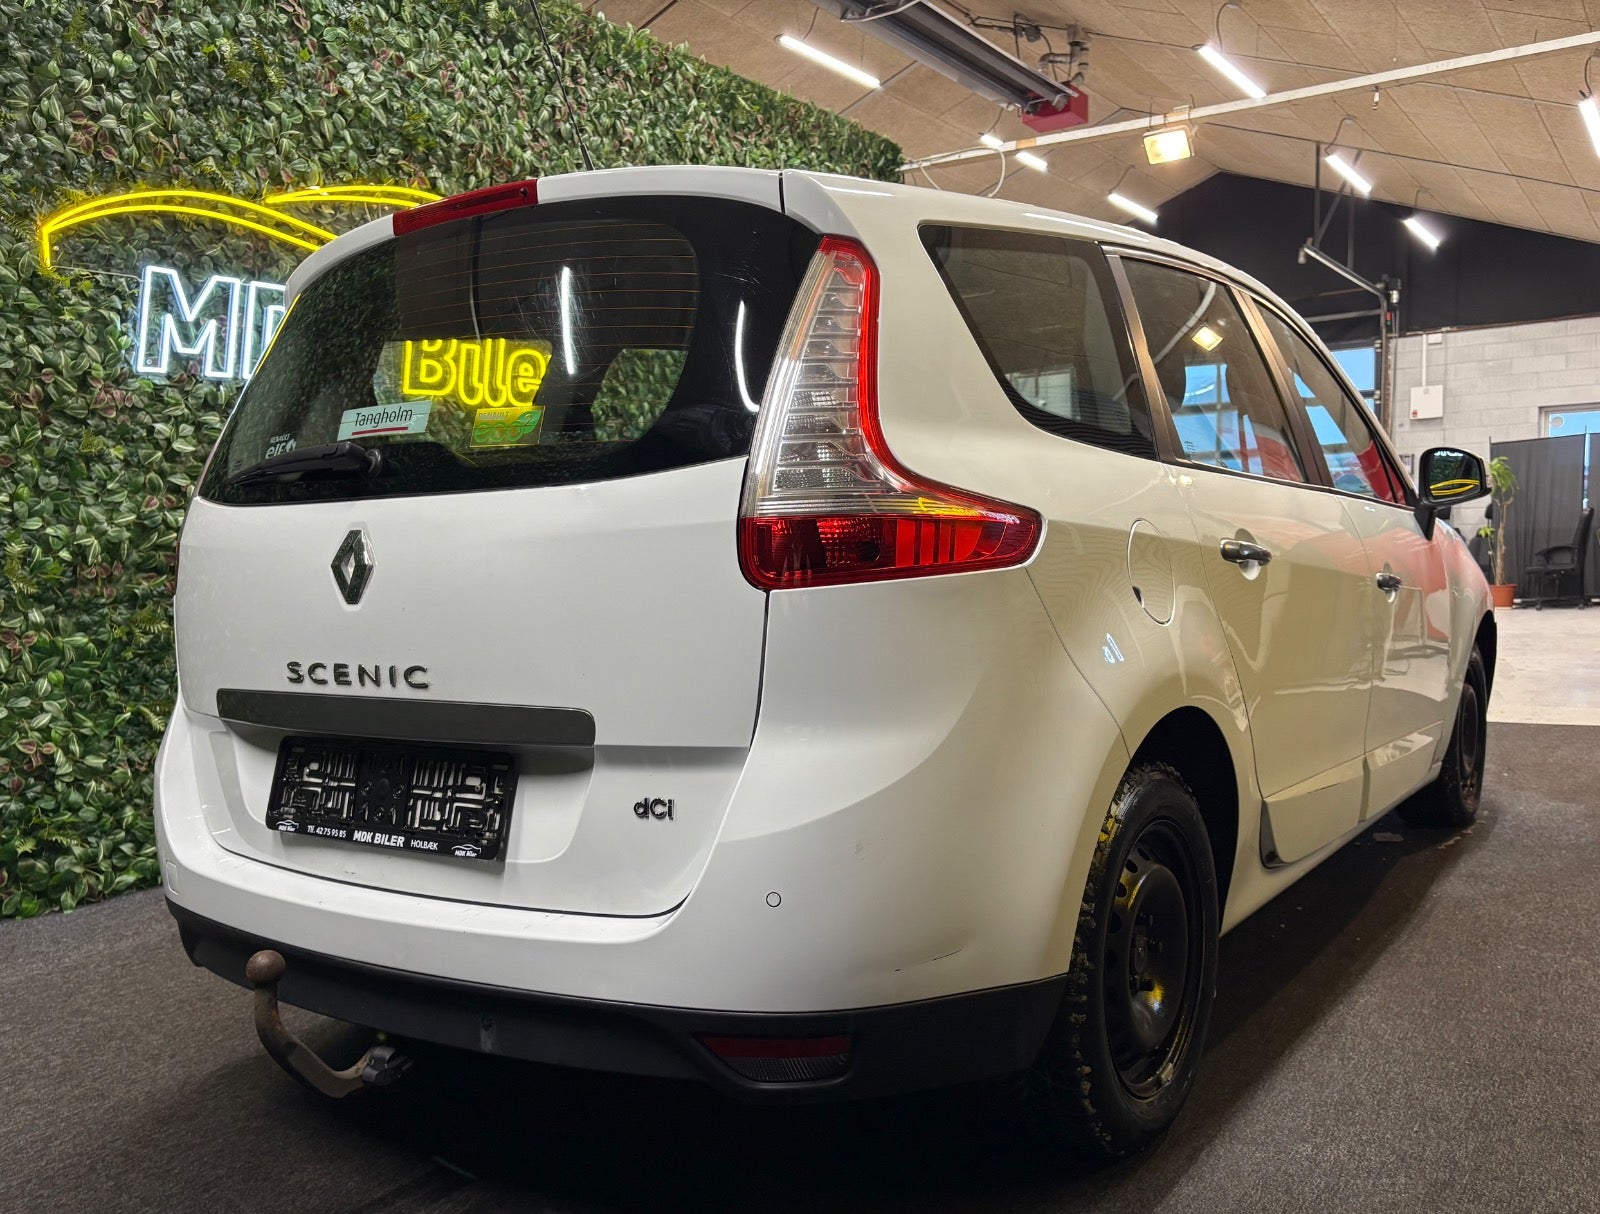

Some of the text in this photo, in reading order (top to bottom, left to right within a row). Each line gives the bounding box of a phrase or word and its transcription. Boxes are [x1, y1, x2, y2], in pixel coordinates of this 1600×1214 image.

[354, 406, 414, 428] Tangholm
[287, 661, 429, 689] SCENIC
[633, 797, 675, 821] dCi
[352, 830, 374, 843] MDK
[374, 833, 405, 847] BILER
[410, 839, 438, 850] HOLBÆK
